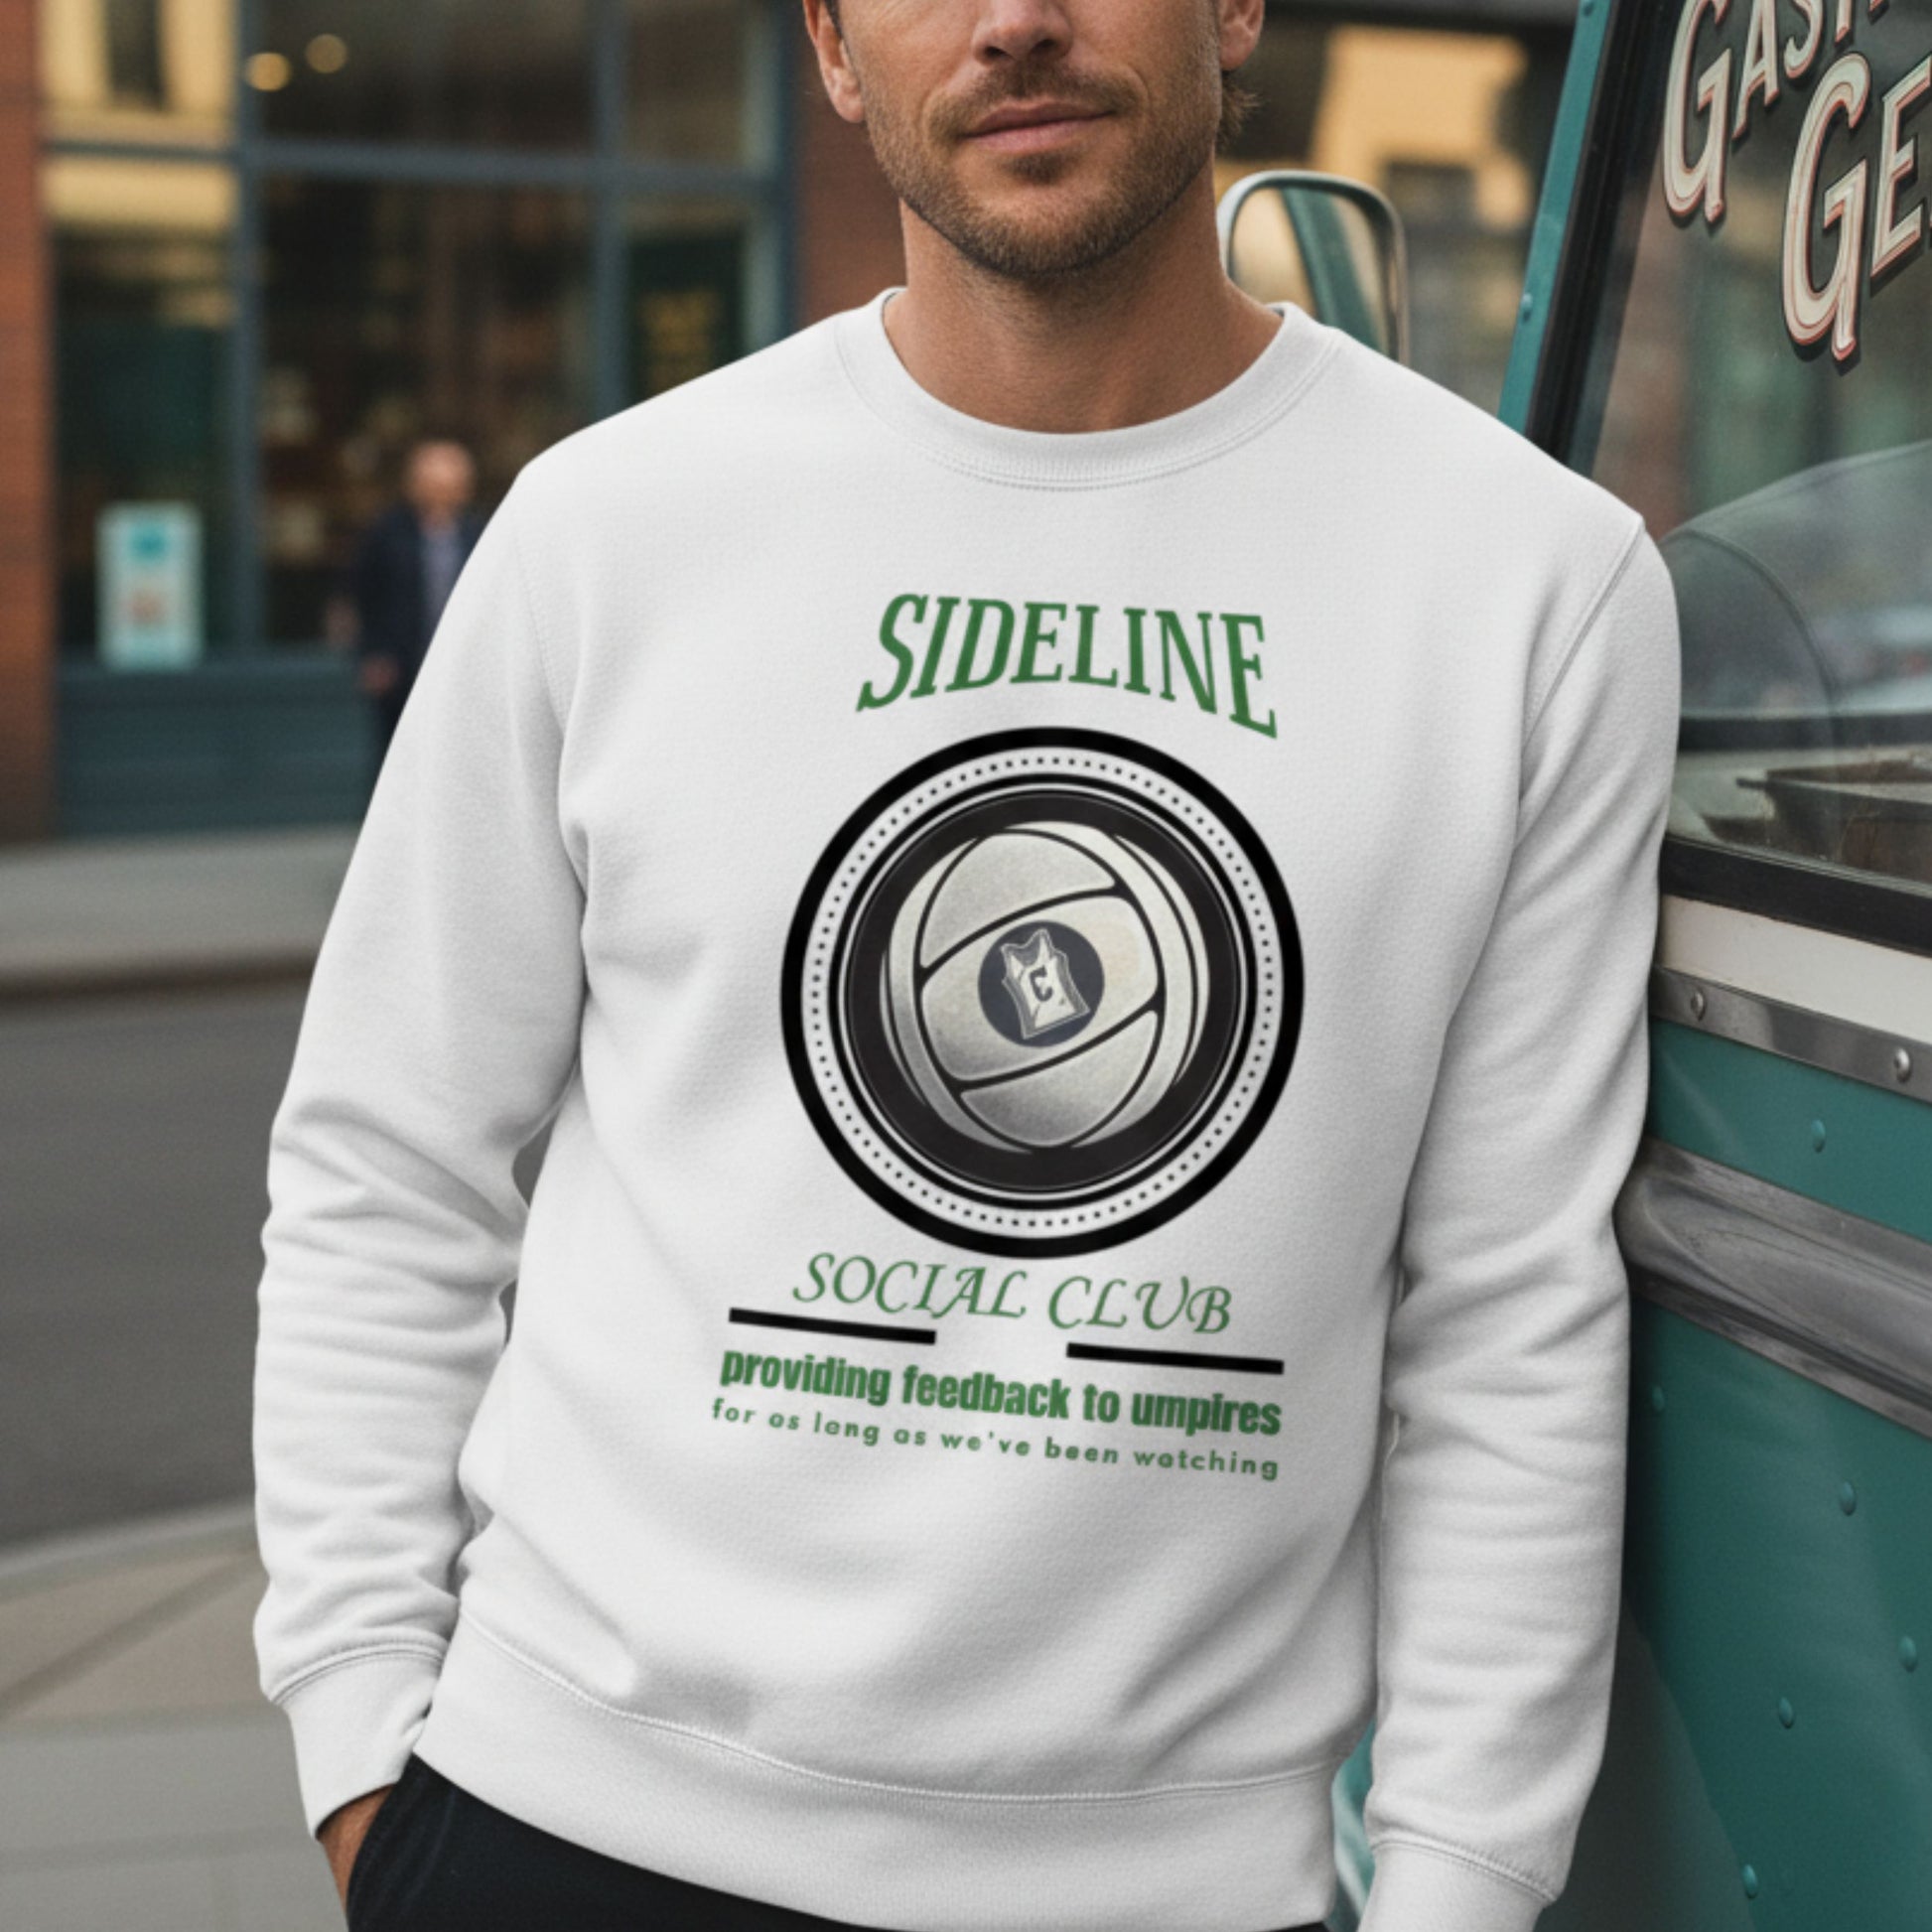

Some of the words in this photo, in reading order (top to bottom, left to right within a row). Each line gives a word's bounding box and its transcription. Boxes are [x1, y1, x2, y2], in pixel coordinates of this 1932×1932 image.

[856, 593, 1279, 740] SIDELINE
[791, 1252, 1028, 1319] SOCIAL
[1047, 1275, 1232, 1334] CLUB
[720, 1350, 892, 1407] providing
[900, 1363, 1071, 1420] feedback
[1082, 1383, 1121, 1423] to
[1131, 1392, 1282, 1438] umpires
[712, 1397, 756, 1424] for
[767, 1412, 800, 1431] as
[813, 1412, 881, 1447] long
[893, 1428, 926, 1447] as
[940, 1430, 1031, 1457] we've
[1043, 1436, 1119, 1464] been
[1134, 1449, 1280, 1482] watching
